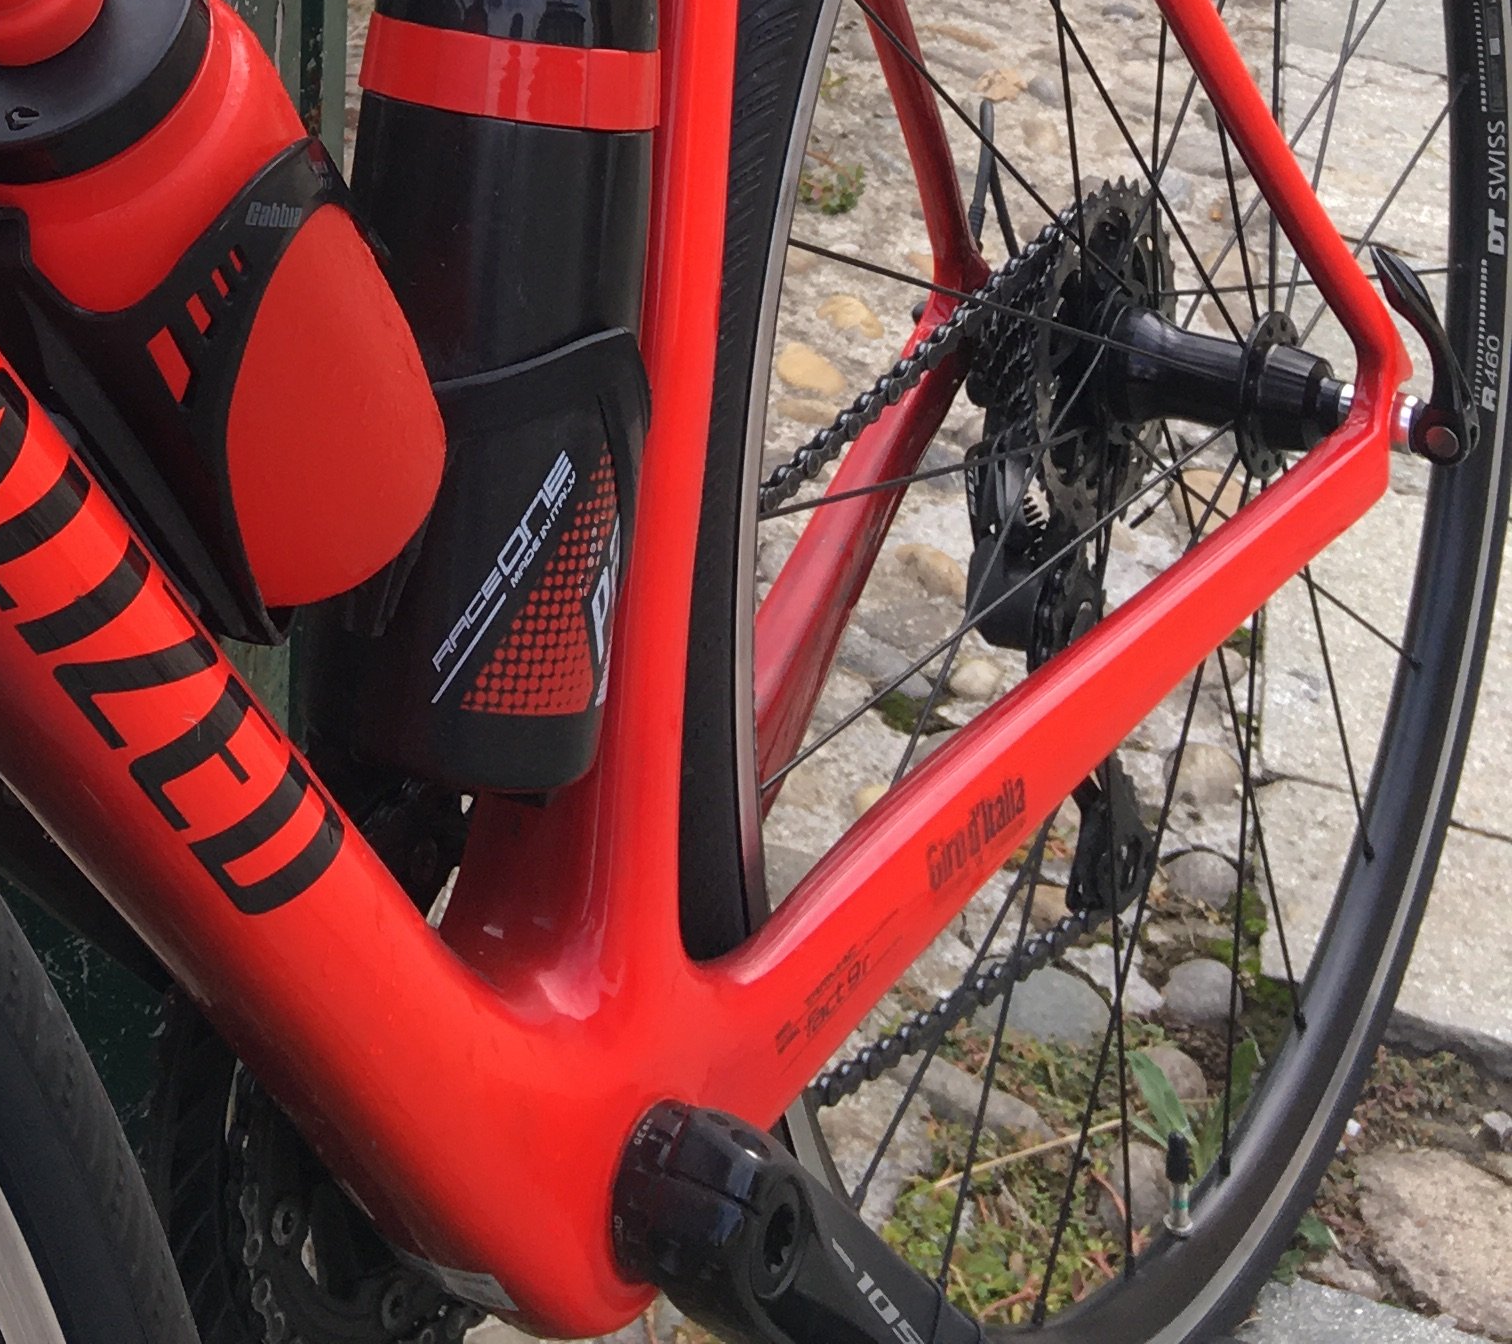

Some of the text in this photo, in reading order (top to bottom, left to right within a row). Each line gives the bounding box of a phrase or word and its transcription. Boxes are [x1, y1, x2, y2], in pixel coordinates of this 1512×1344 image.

[245, 201, 303, 227] Gabbia
[1488, 119, 1507, 256] DT SWISS
[510, 470, 576, 588] MADE IN ITALY
[857, 1271, 925, 1344] 105
